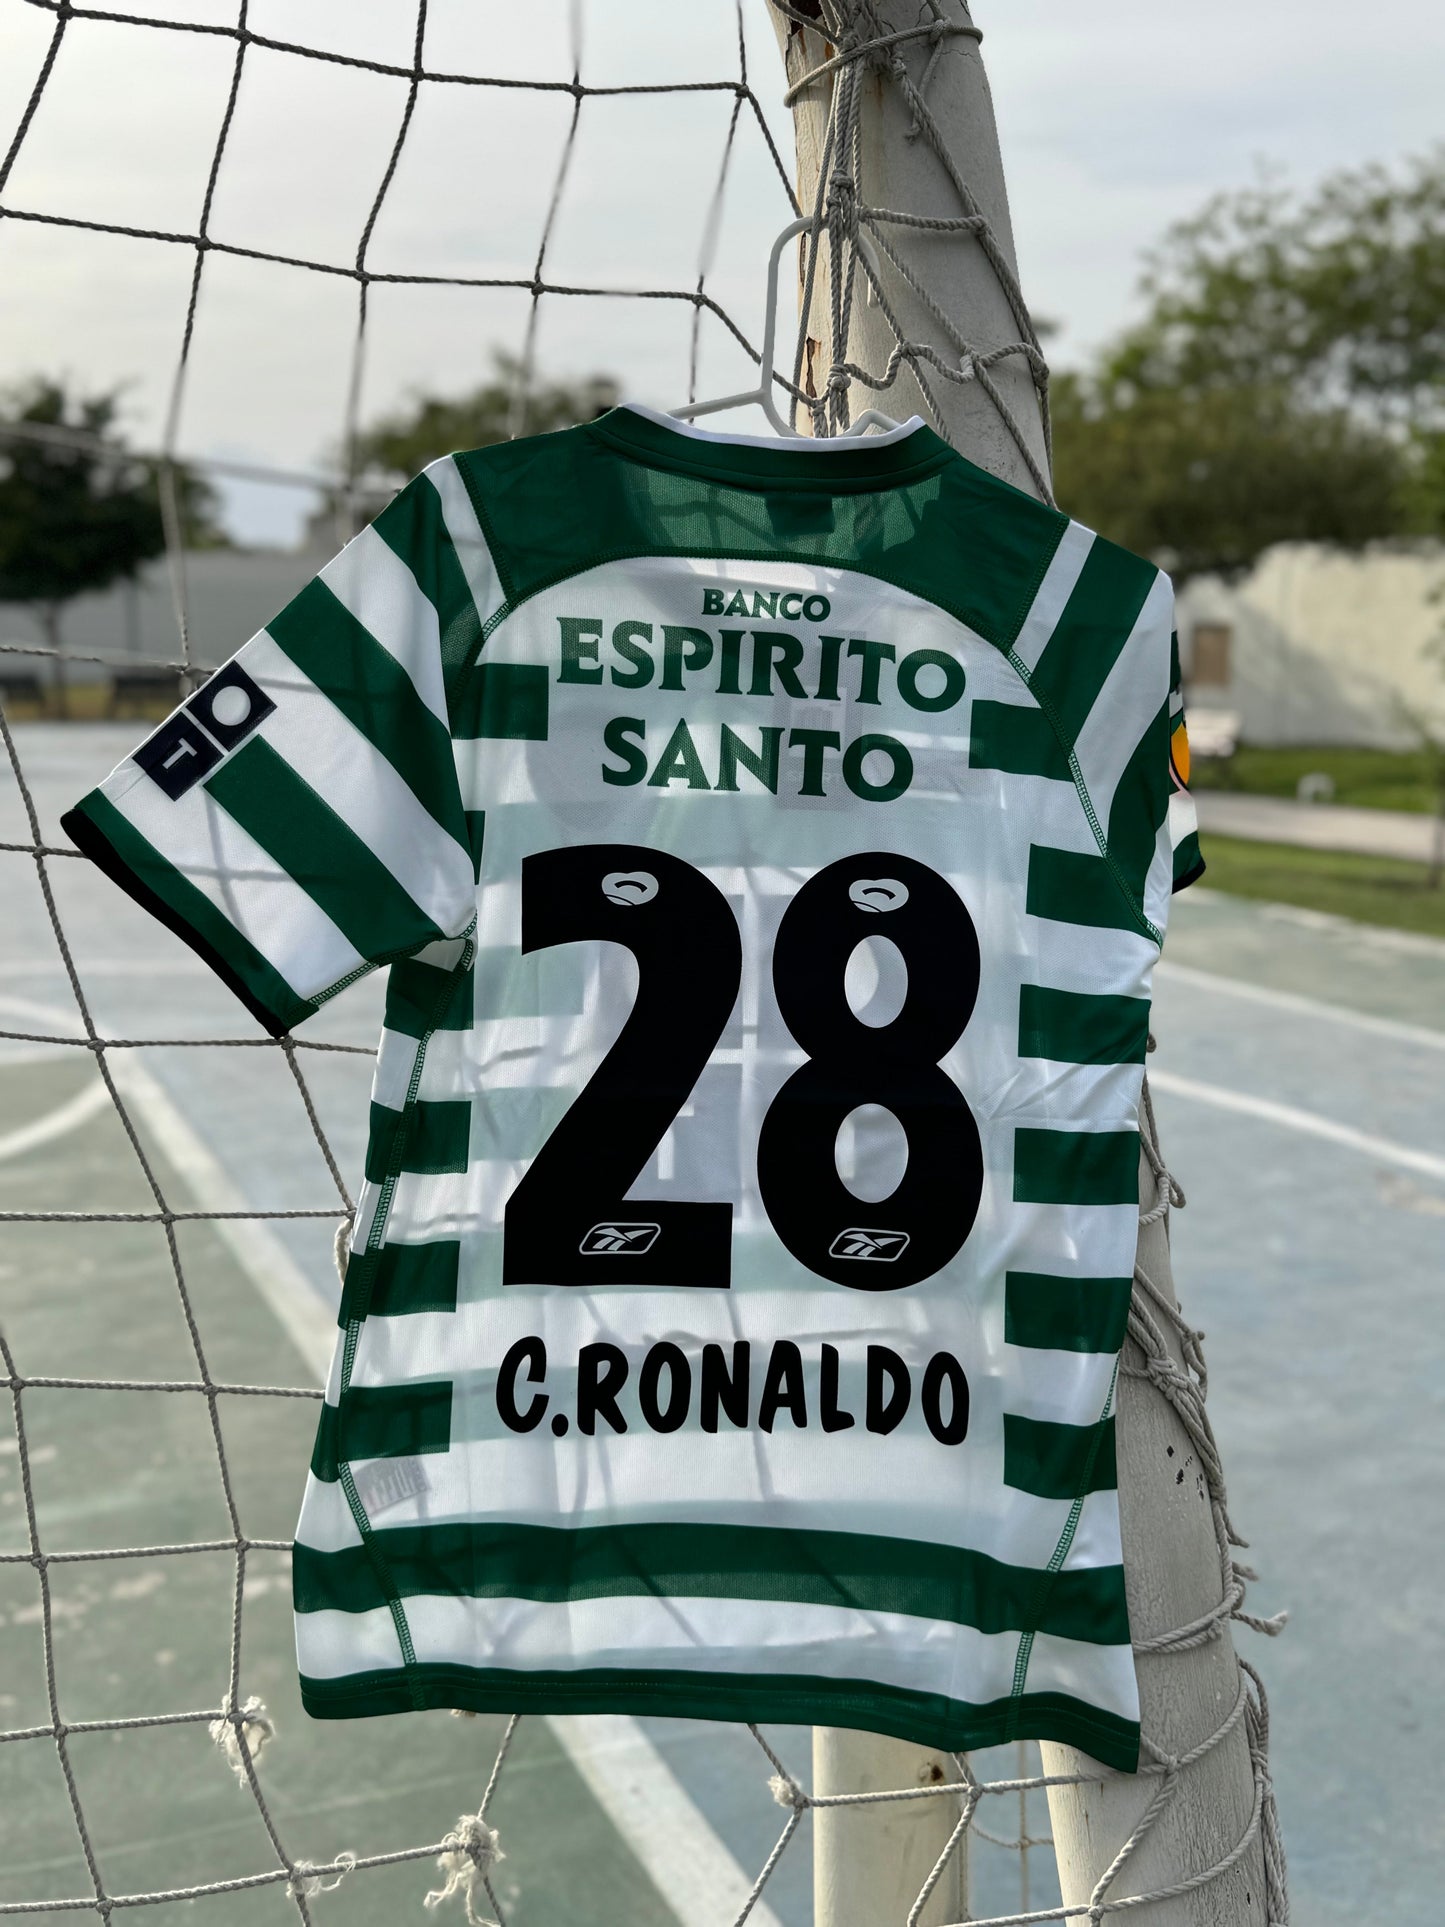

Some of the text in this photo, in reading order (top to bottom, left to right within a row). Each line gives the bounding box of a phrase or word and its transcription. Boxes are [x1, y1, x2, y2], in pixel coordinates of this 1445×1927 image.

[701, 588, 832, 623] BANCO
[556, 616, 967, 714] ESPIRITO
[601, 715, 915, 803] SANTO
[503, 843, 984, 1292] 28
[495, 1335, 970, 1446] C.RONALDO
